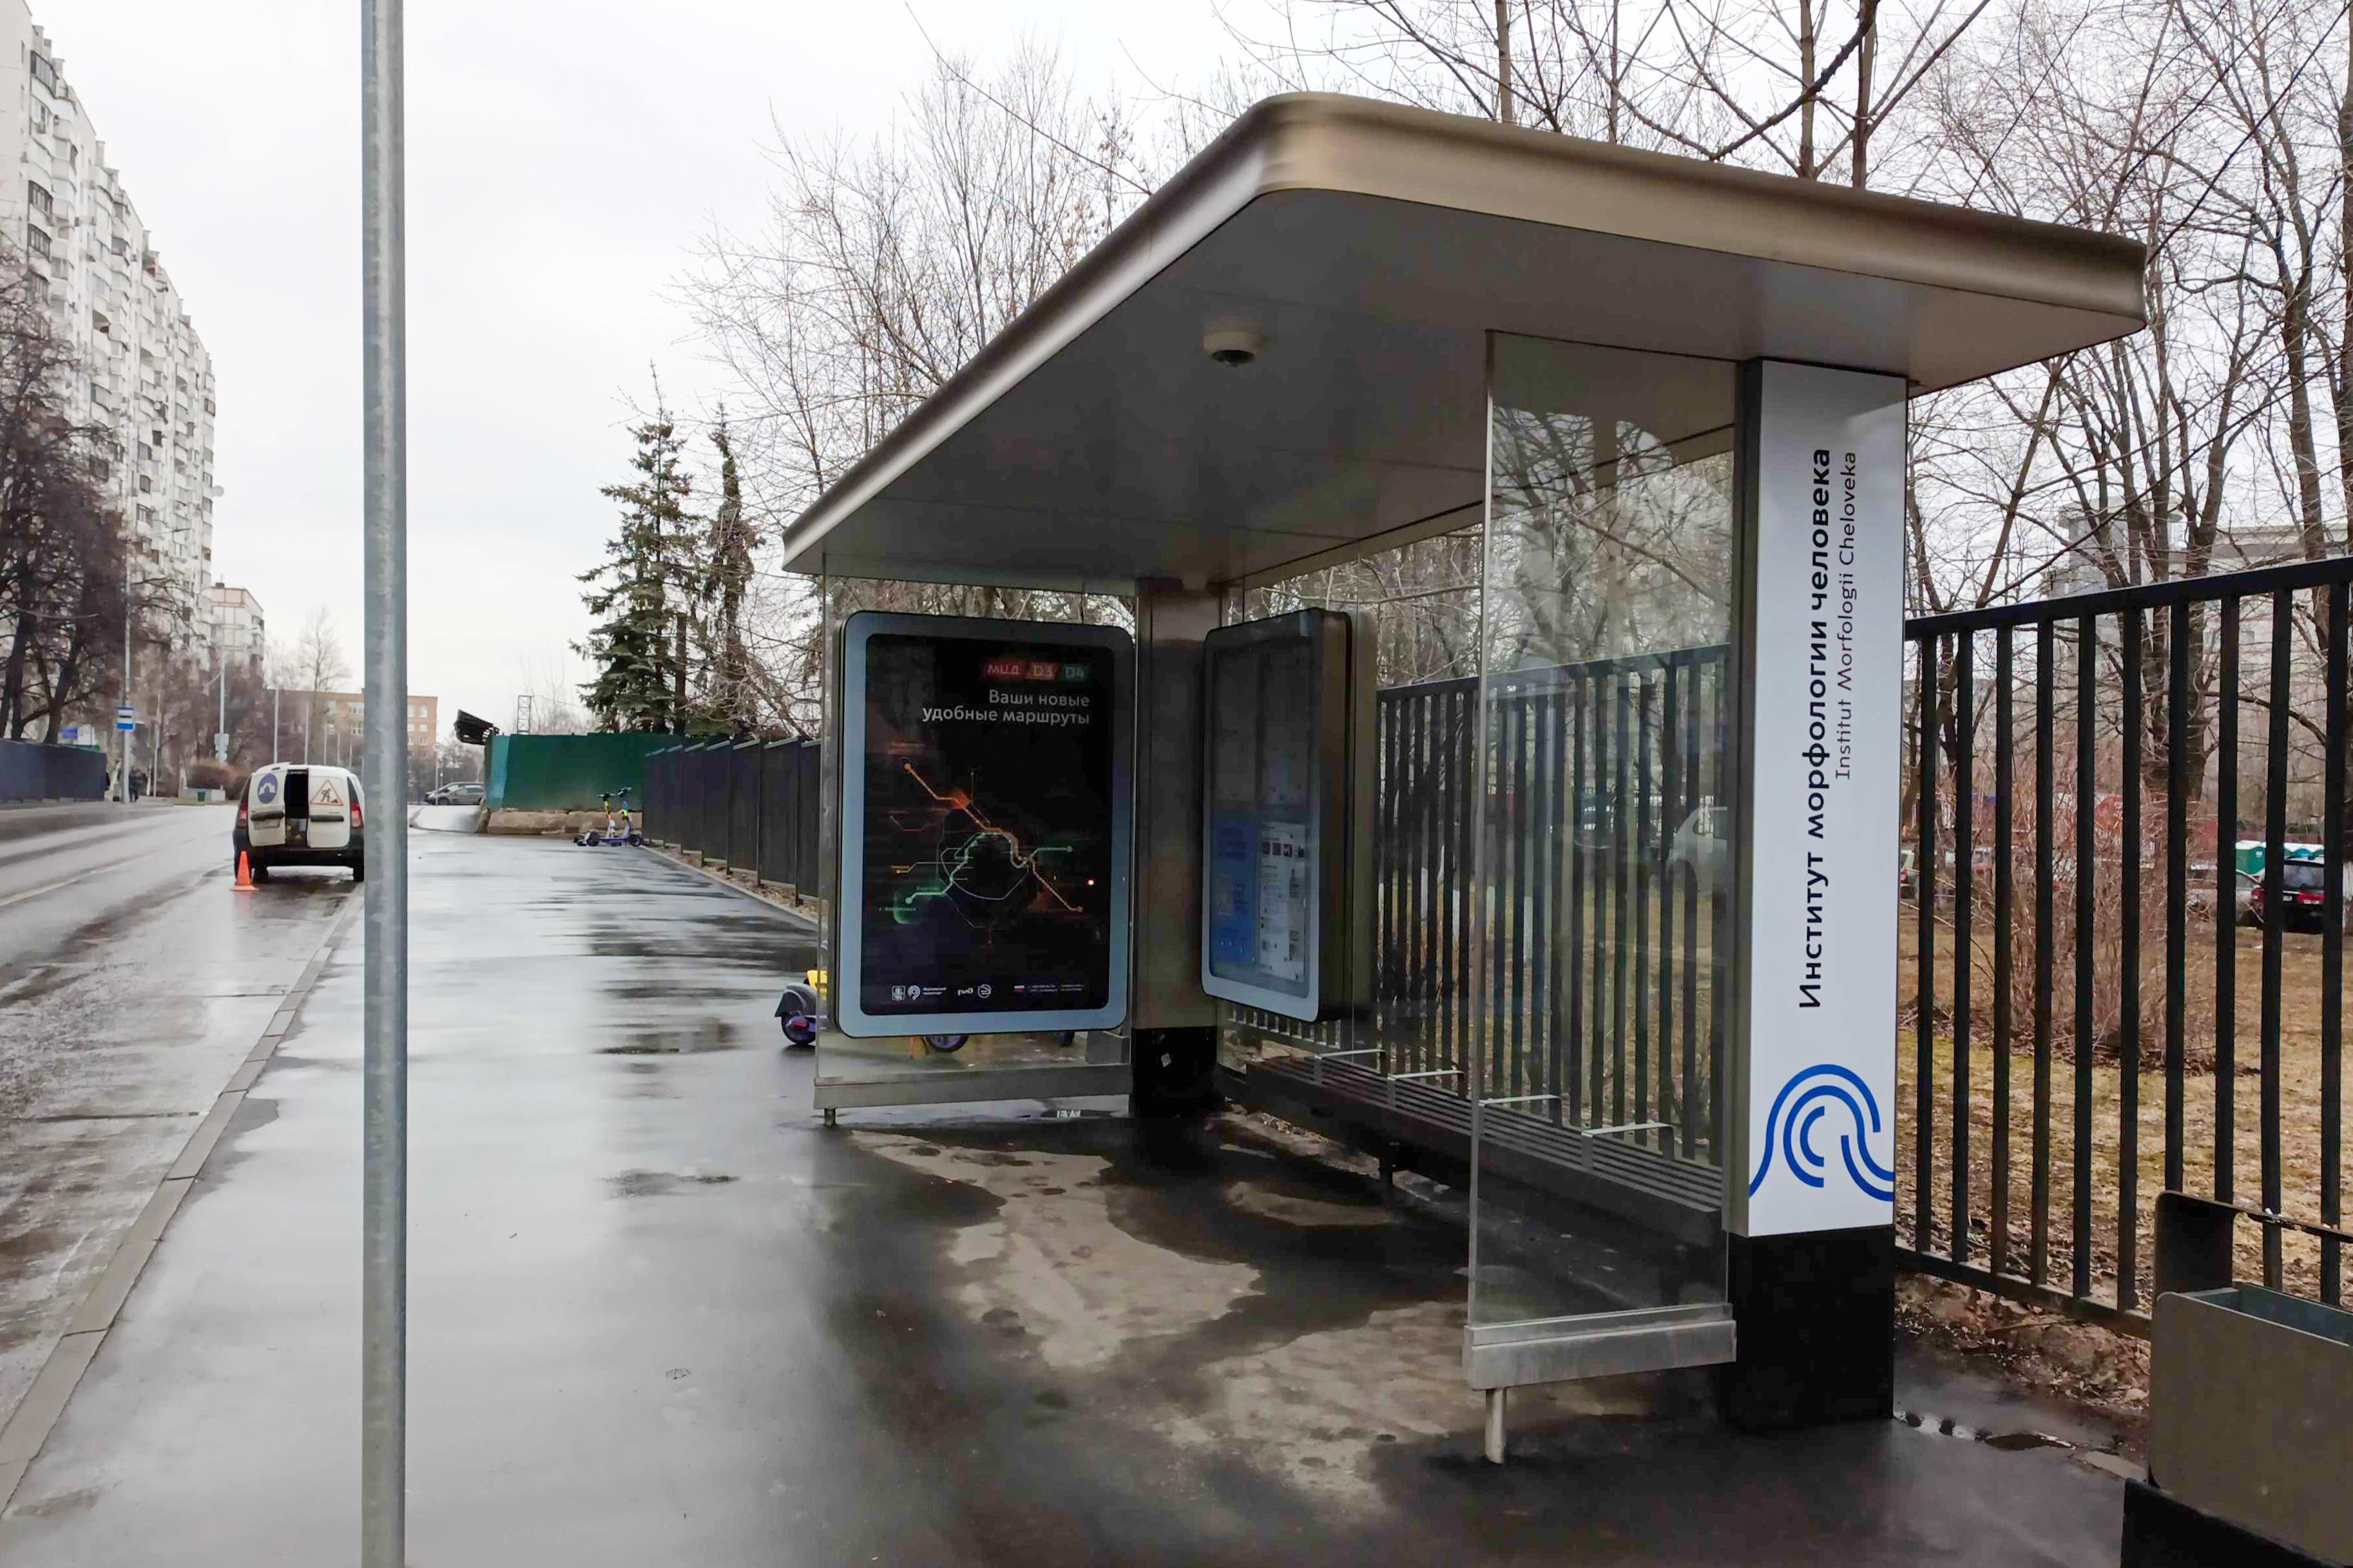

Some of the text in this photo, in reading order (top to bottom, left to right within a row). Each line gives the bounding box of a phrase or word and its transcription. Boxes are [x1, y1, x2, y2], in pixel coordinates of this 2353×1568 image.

[1835, 452, 1857, 779] Institut Morfologii Cheloveka
[987, 663, 1085, 678] МЦД D3 D4
[988, 689, 1091, 707] Ваши новые
[922, 705, 1090, 727] удобные маршруты
[1799, 448, 1830, 1008] Институт морфологии человека
